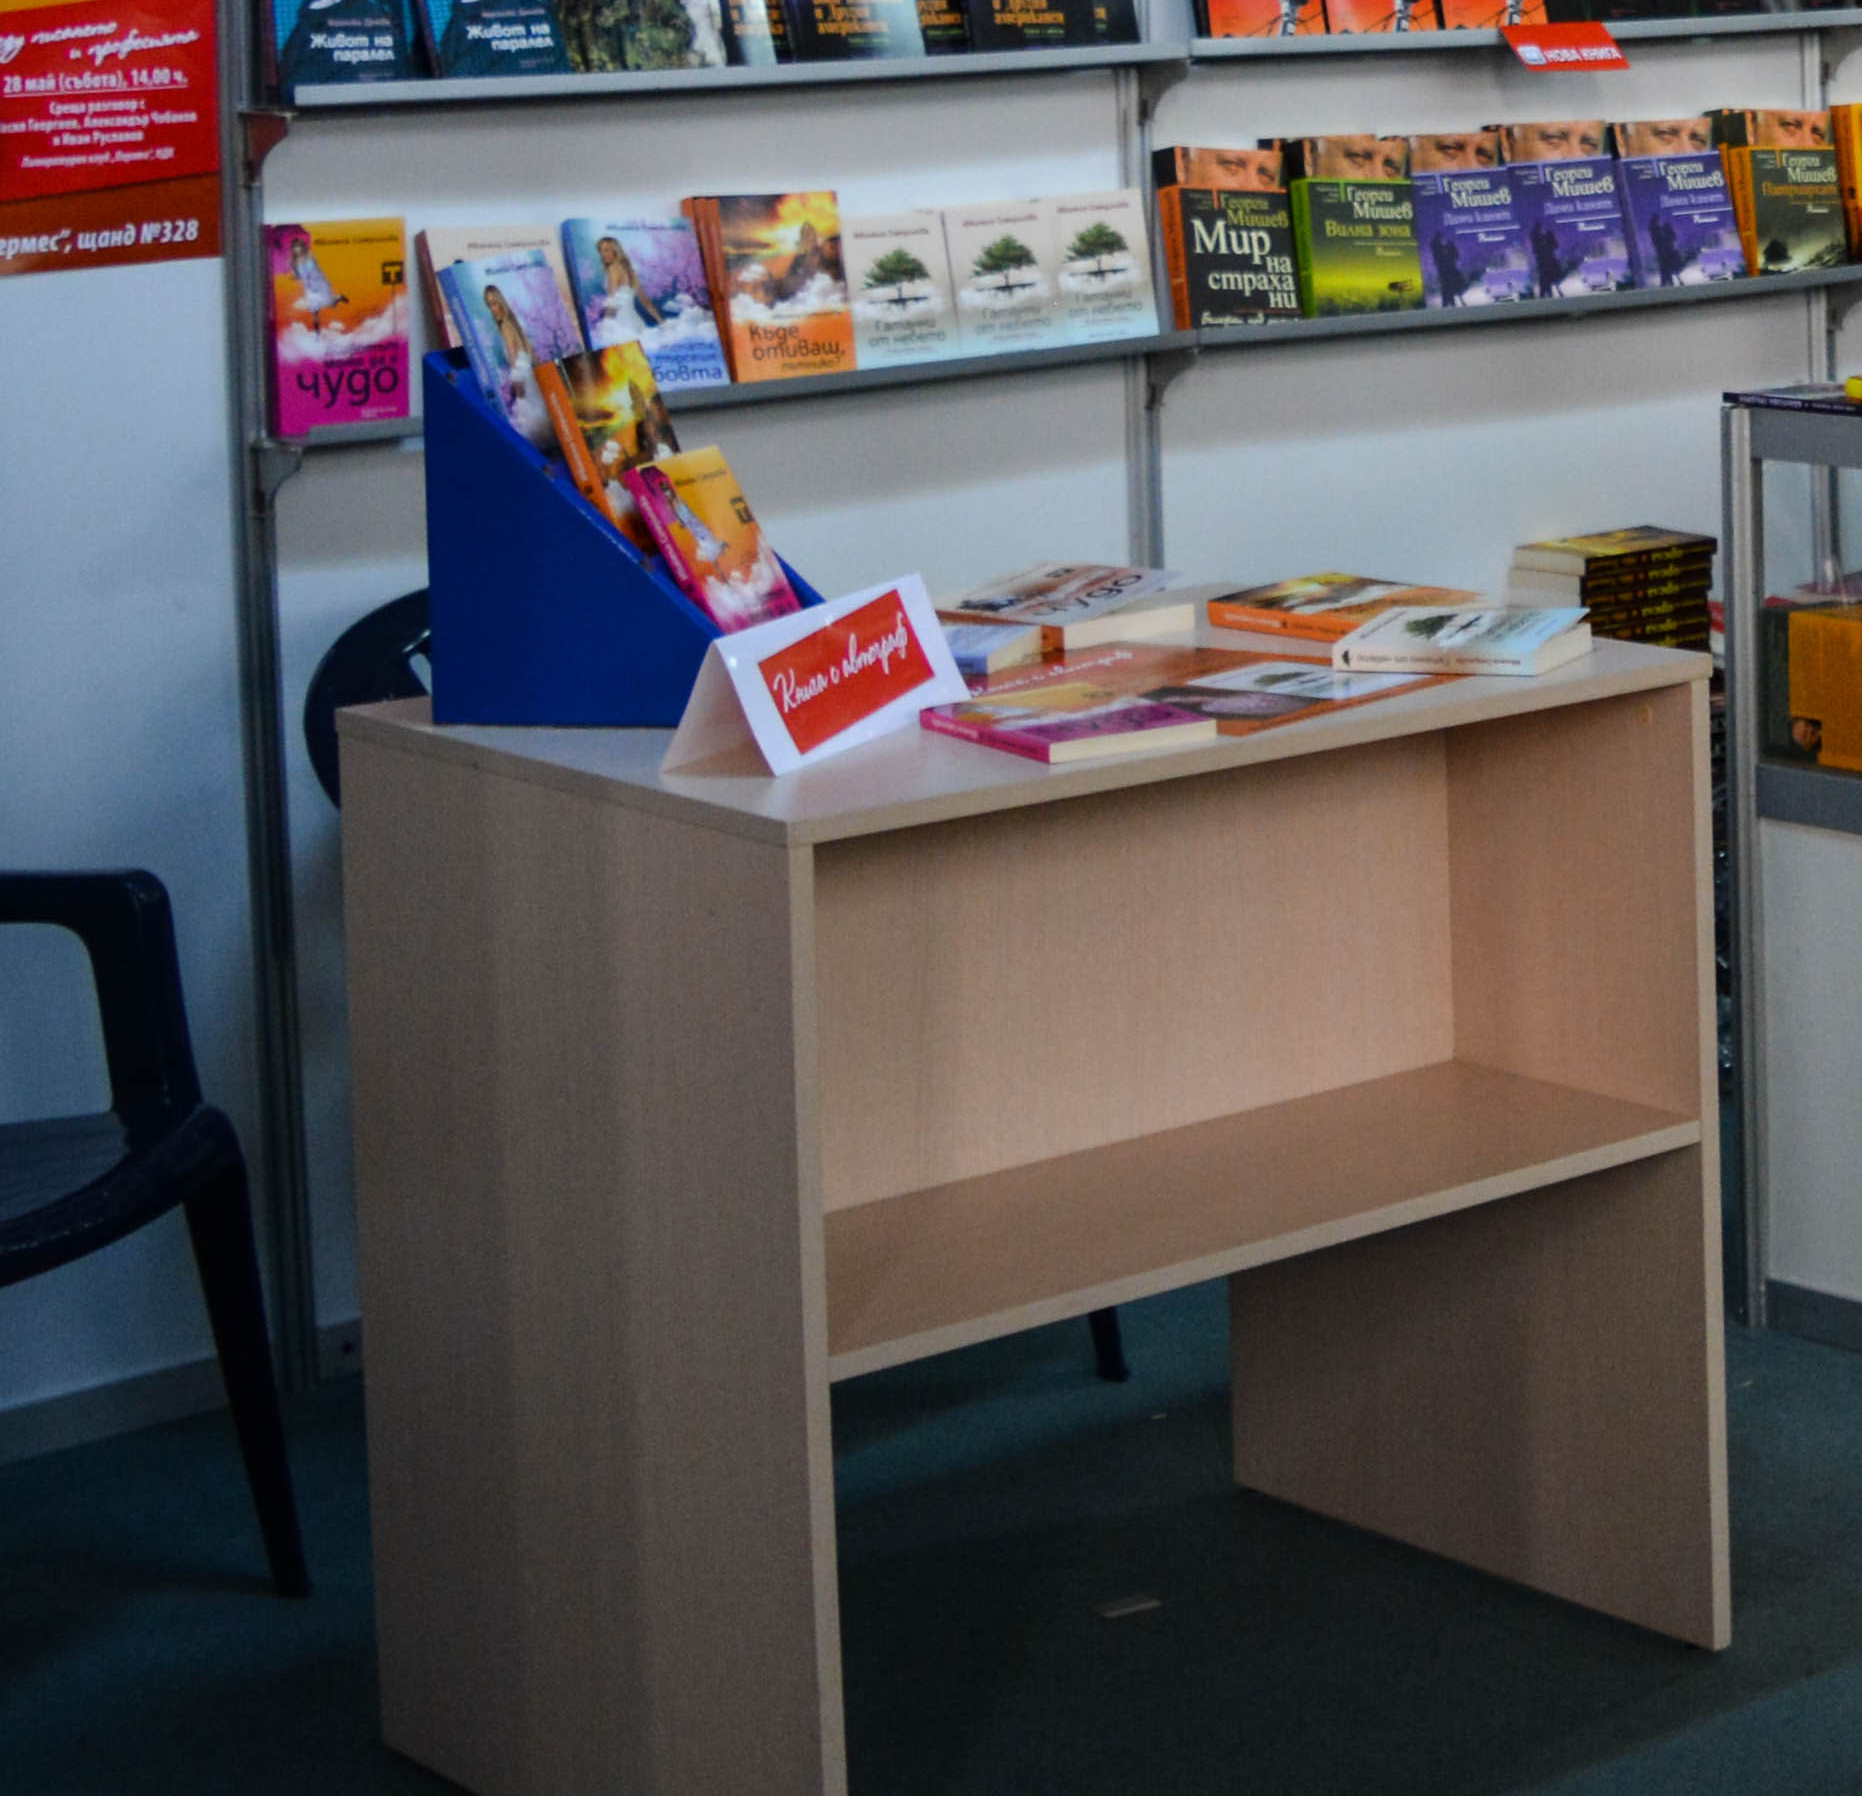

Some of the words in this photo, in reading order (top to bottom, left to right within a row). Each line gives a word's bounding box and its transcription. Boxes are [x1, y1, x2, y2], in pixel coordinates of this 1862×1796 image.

[309, 32, 370, 50] Живот
[374, 34, 393, 48] на
[466, 22, 528, 41] Живот
[531, 22, 550, 36] на
[491, 35, 554, 52] паралел
[333, 47, 395, 63] паралел
[1782, 151, 1821, 168] Георги
[1544, 166, 1593, 184] Георги
[1659, 160, 1704, 179] Георги
[1787, 165, 1837, 183] Мишев
[1443, 176, 1490, 194] Георги
[1553, 177, 1614, 197] Мишев
[1667, 171, 1724, 192] Мишев
[1219, 194, 1269, 212] Георги
[1347, 185, 1395, 203] Георги
[1452, 187, 1511, 208] Мишев
[1227, 210, 1289, 229] Мишев
[1353, 202, 1413, 220] Мишев
[77, 222, 137, 252] щанд
[1192, 220, 1272, 263] Мир
[1266, 254, 1292, 273] на
[1208, 270, 1295, 296] страха
[1270, 291, 1297, 309] ни
[749, 323, 799, 343] Къде
[752, 338, 846, 361] отиваш,
[297, 363, 399, 409] чудо
[829, 666, 839, 684] с
[842, 610, 907, 679] автограф
